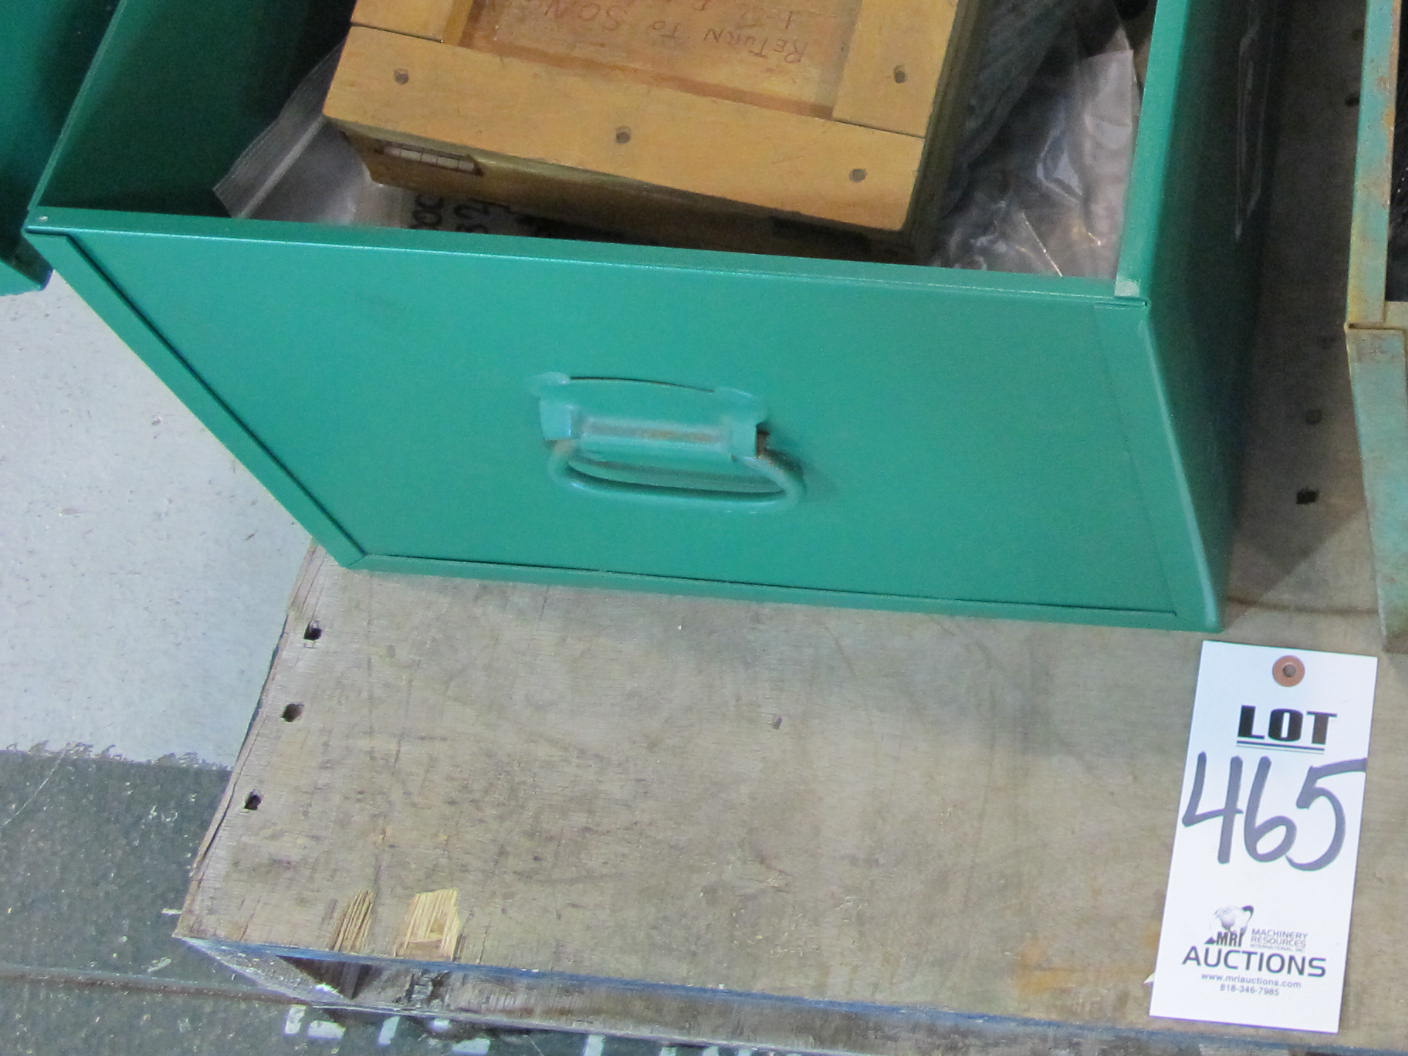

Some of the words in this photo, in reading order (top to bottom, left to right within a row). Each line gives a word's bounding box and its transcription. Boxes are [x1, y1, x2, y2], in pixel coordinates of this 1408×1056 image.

[1236, 705, 1337, 746] LOT
[1182, 752, 1368, 871] 465
[1216, 927, 1247, 947] MRI
[1251, 928, 1308, 939] MACHINERY
[1182, 945, 1327, 978] AUCTIONS
[1201, 973, 1302, 989] www.mriauctions.com
